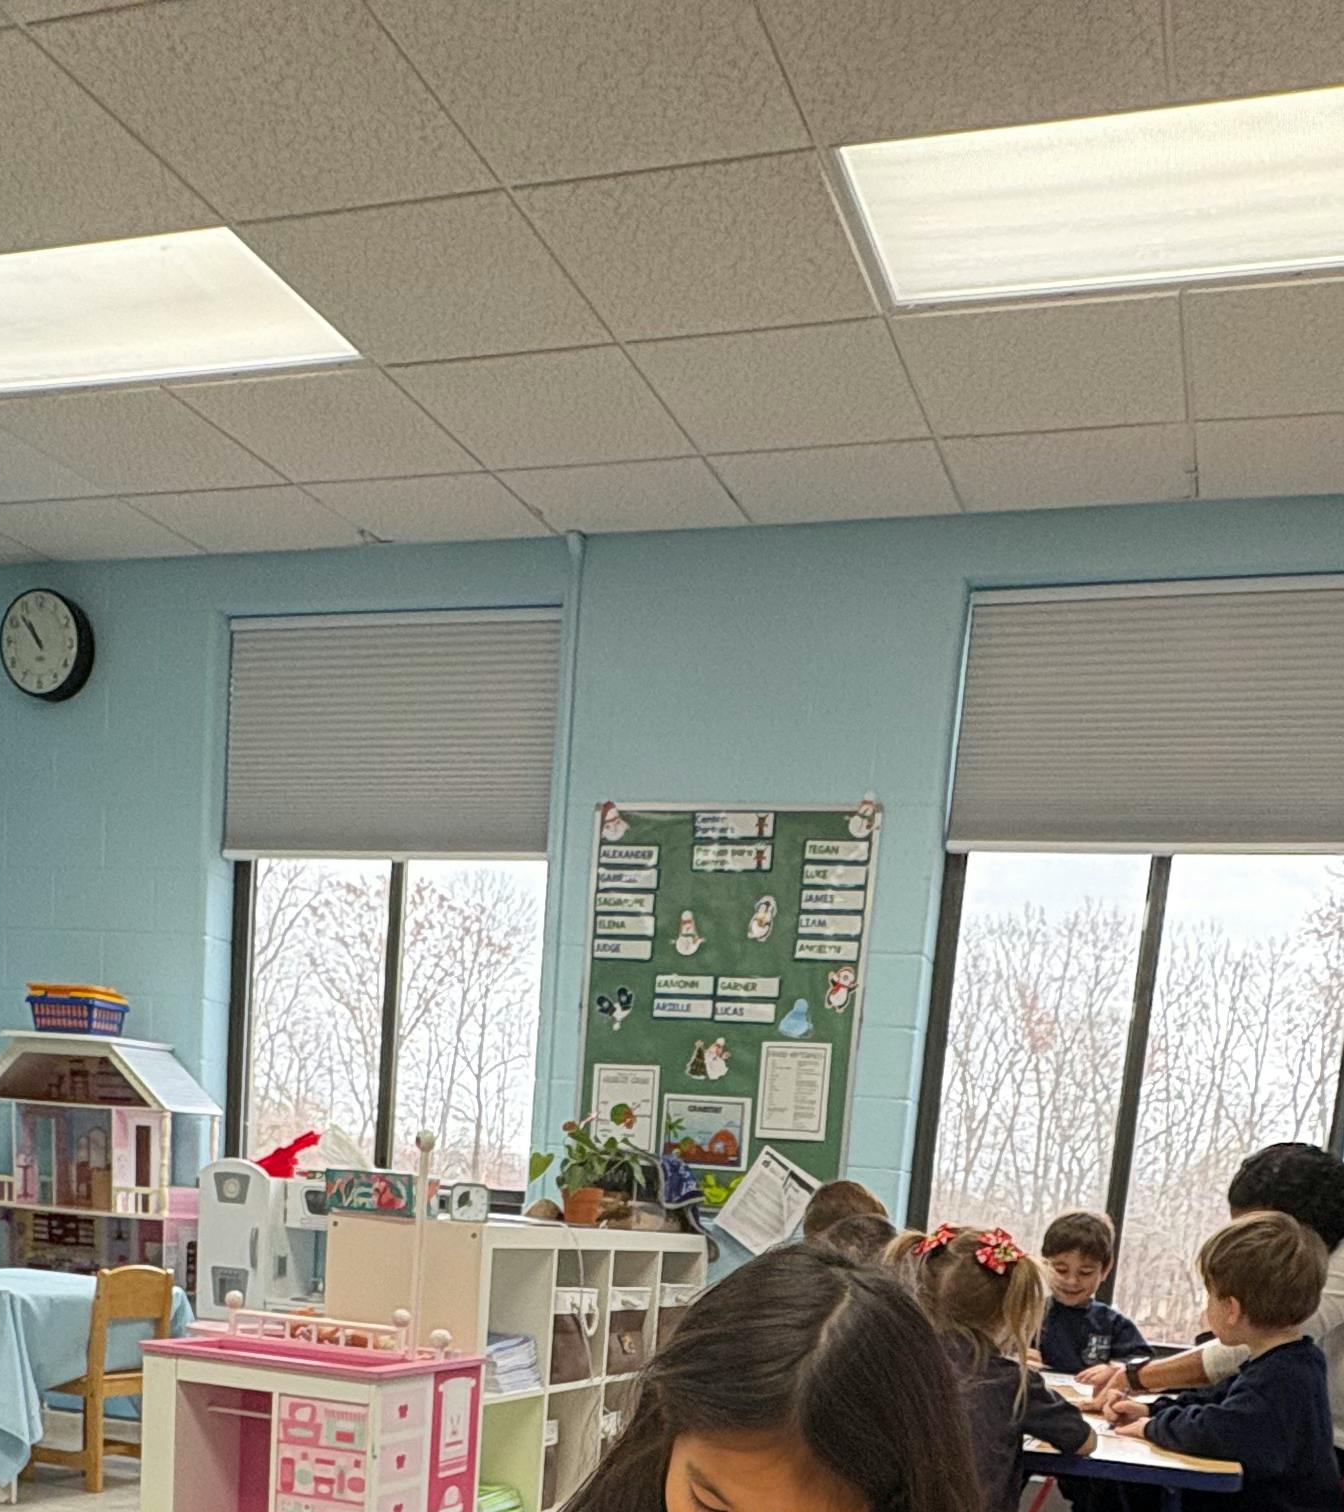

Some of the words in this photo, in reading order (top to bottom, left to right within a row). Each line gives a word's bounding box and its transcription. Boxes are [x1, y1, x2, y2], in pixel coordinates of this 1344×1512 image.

[808, 845, 839, 855] TEGAN
[805, 894, 834, 904] JAMES
[800, 918, 827, 928] LIAM
[720, 982, 757, 992] GARNER
[716, 1007, 744, 1016] LUCAS
